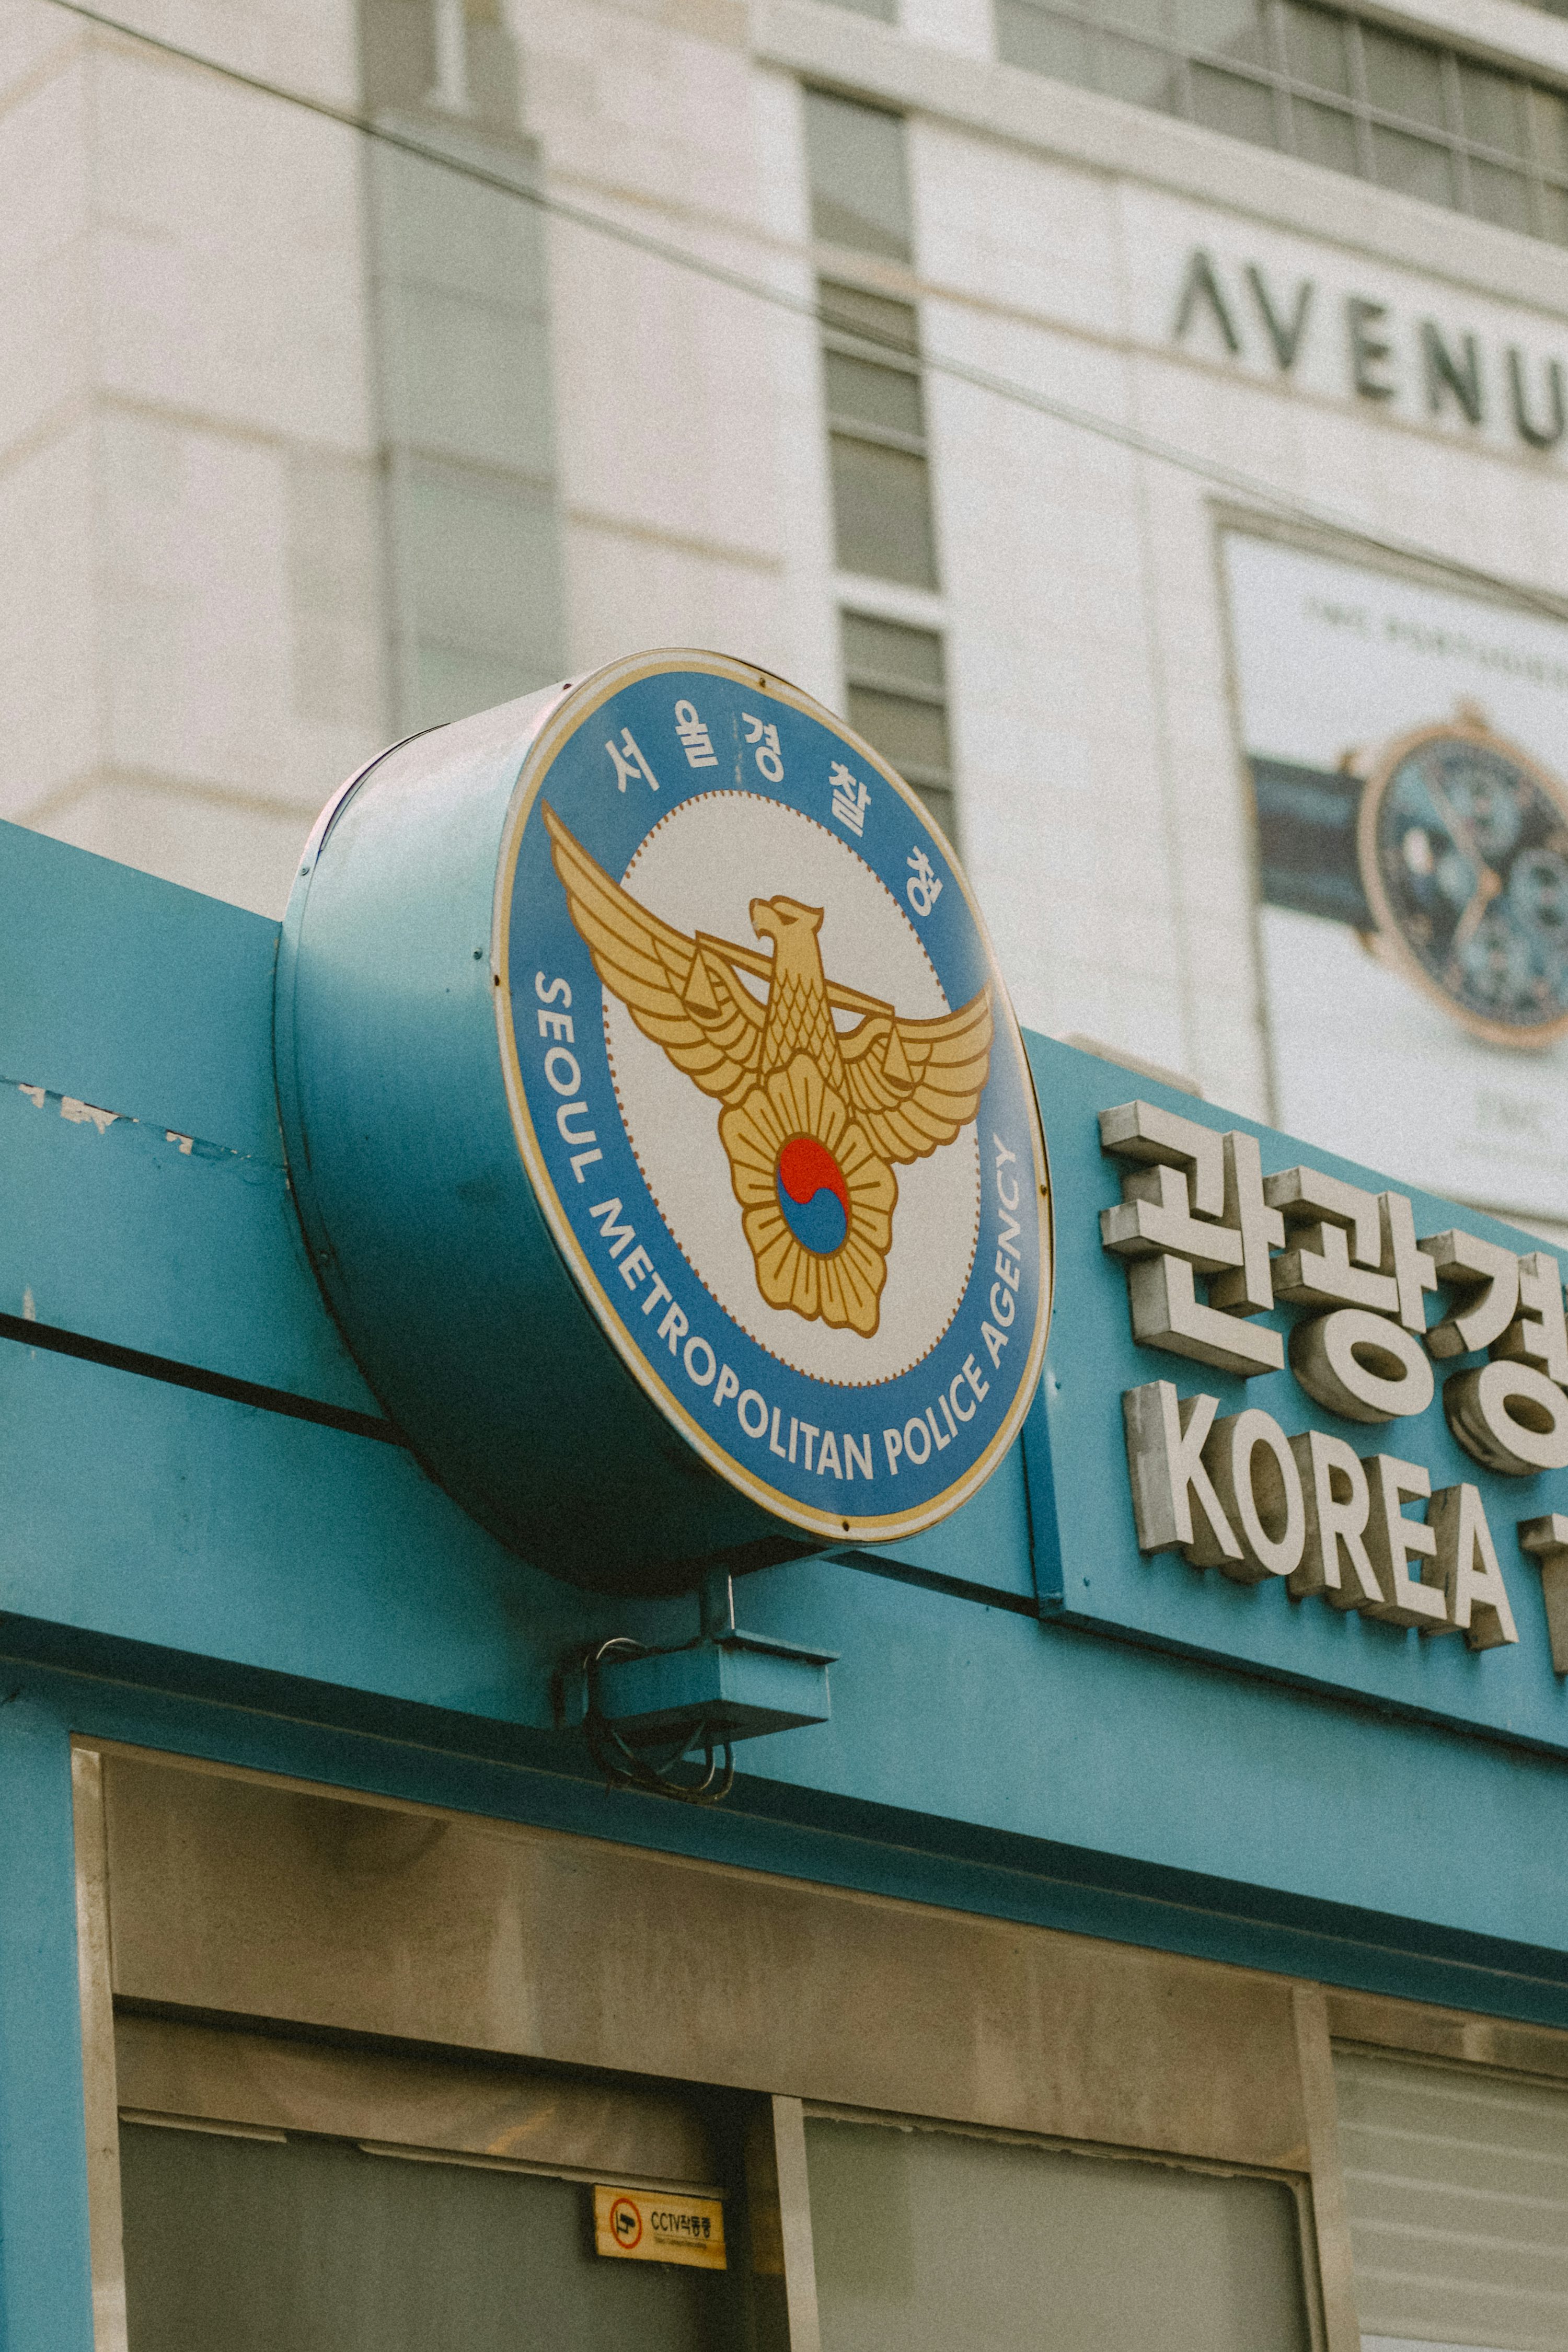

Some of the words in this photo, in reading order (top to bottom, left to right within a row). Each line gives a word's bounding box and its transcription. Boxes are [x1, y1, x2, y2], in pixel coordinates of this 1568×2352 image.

[1170, 248, 1567, 451] AVENU
[605, 699, 943, 917] 서울경찰청
[535, 971, 603, 1184] SEOUL
[589, 1197, 874, 1481] METROPOLITAN
[883, 1352, 990, 1475] POLICE
[980, 1132, 1021, 1370] AGENCY
[1098, 1100, 1568, 1476] 관광경
[1123, 1379, 1519, 1651] KOREA
